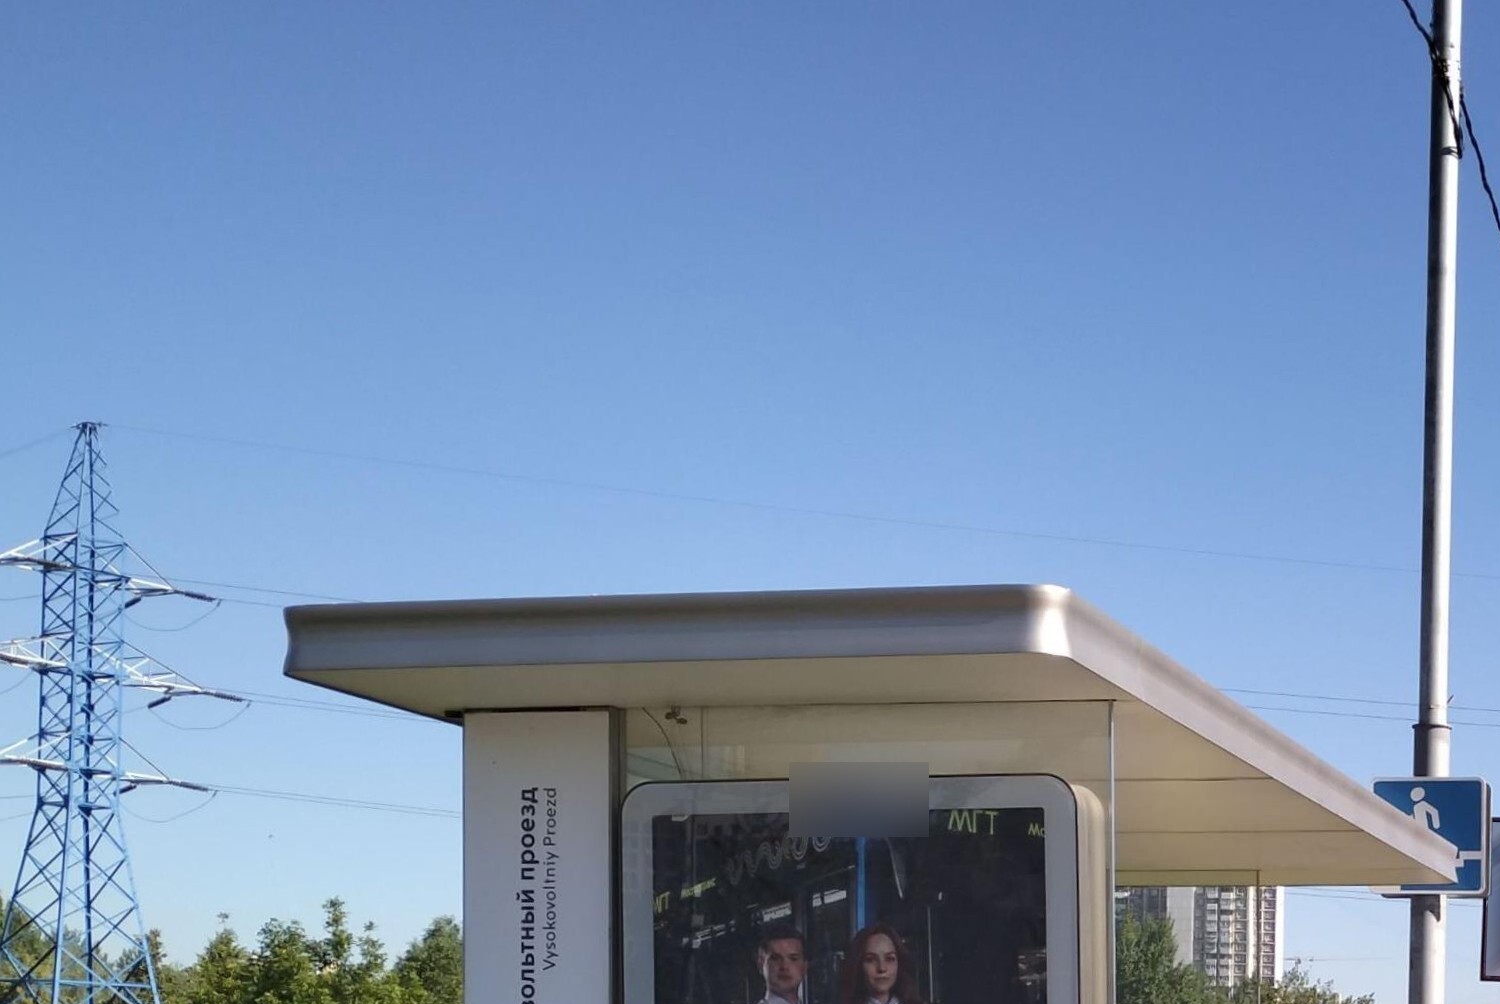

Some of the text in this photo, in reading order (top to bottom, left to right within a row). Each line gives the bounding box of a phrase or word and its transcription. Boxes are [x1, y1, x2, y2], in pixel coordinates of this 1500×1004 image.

[520, 786, 539, 880] проезд
[542, 787, 560, 971] Vysokovoltniy Proezd
